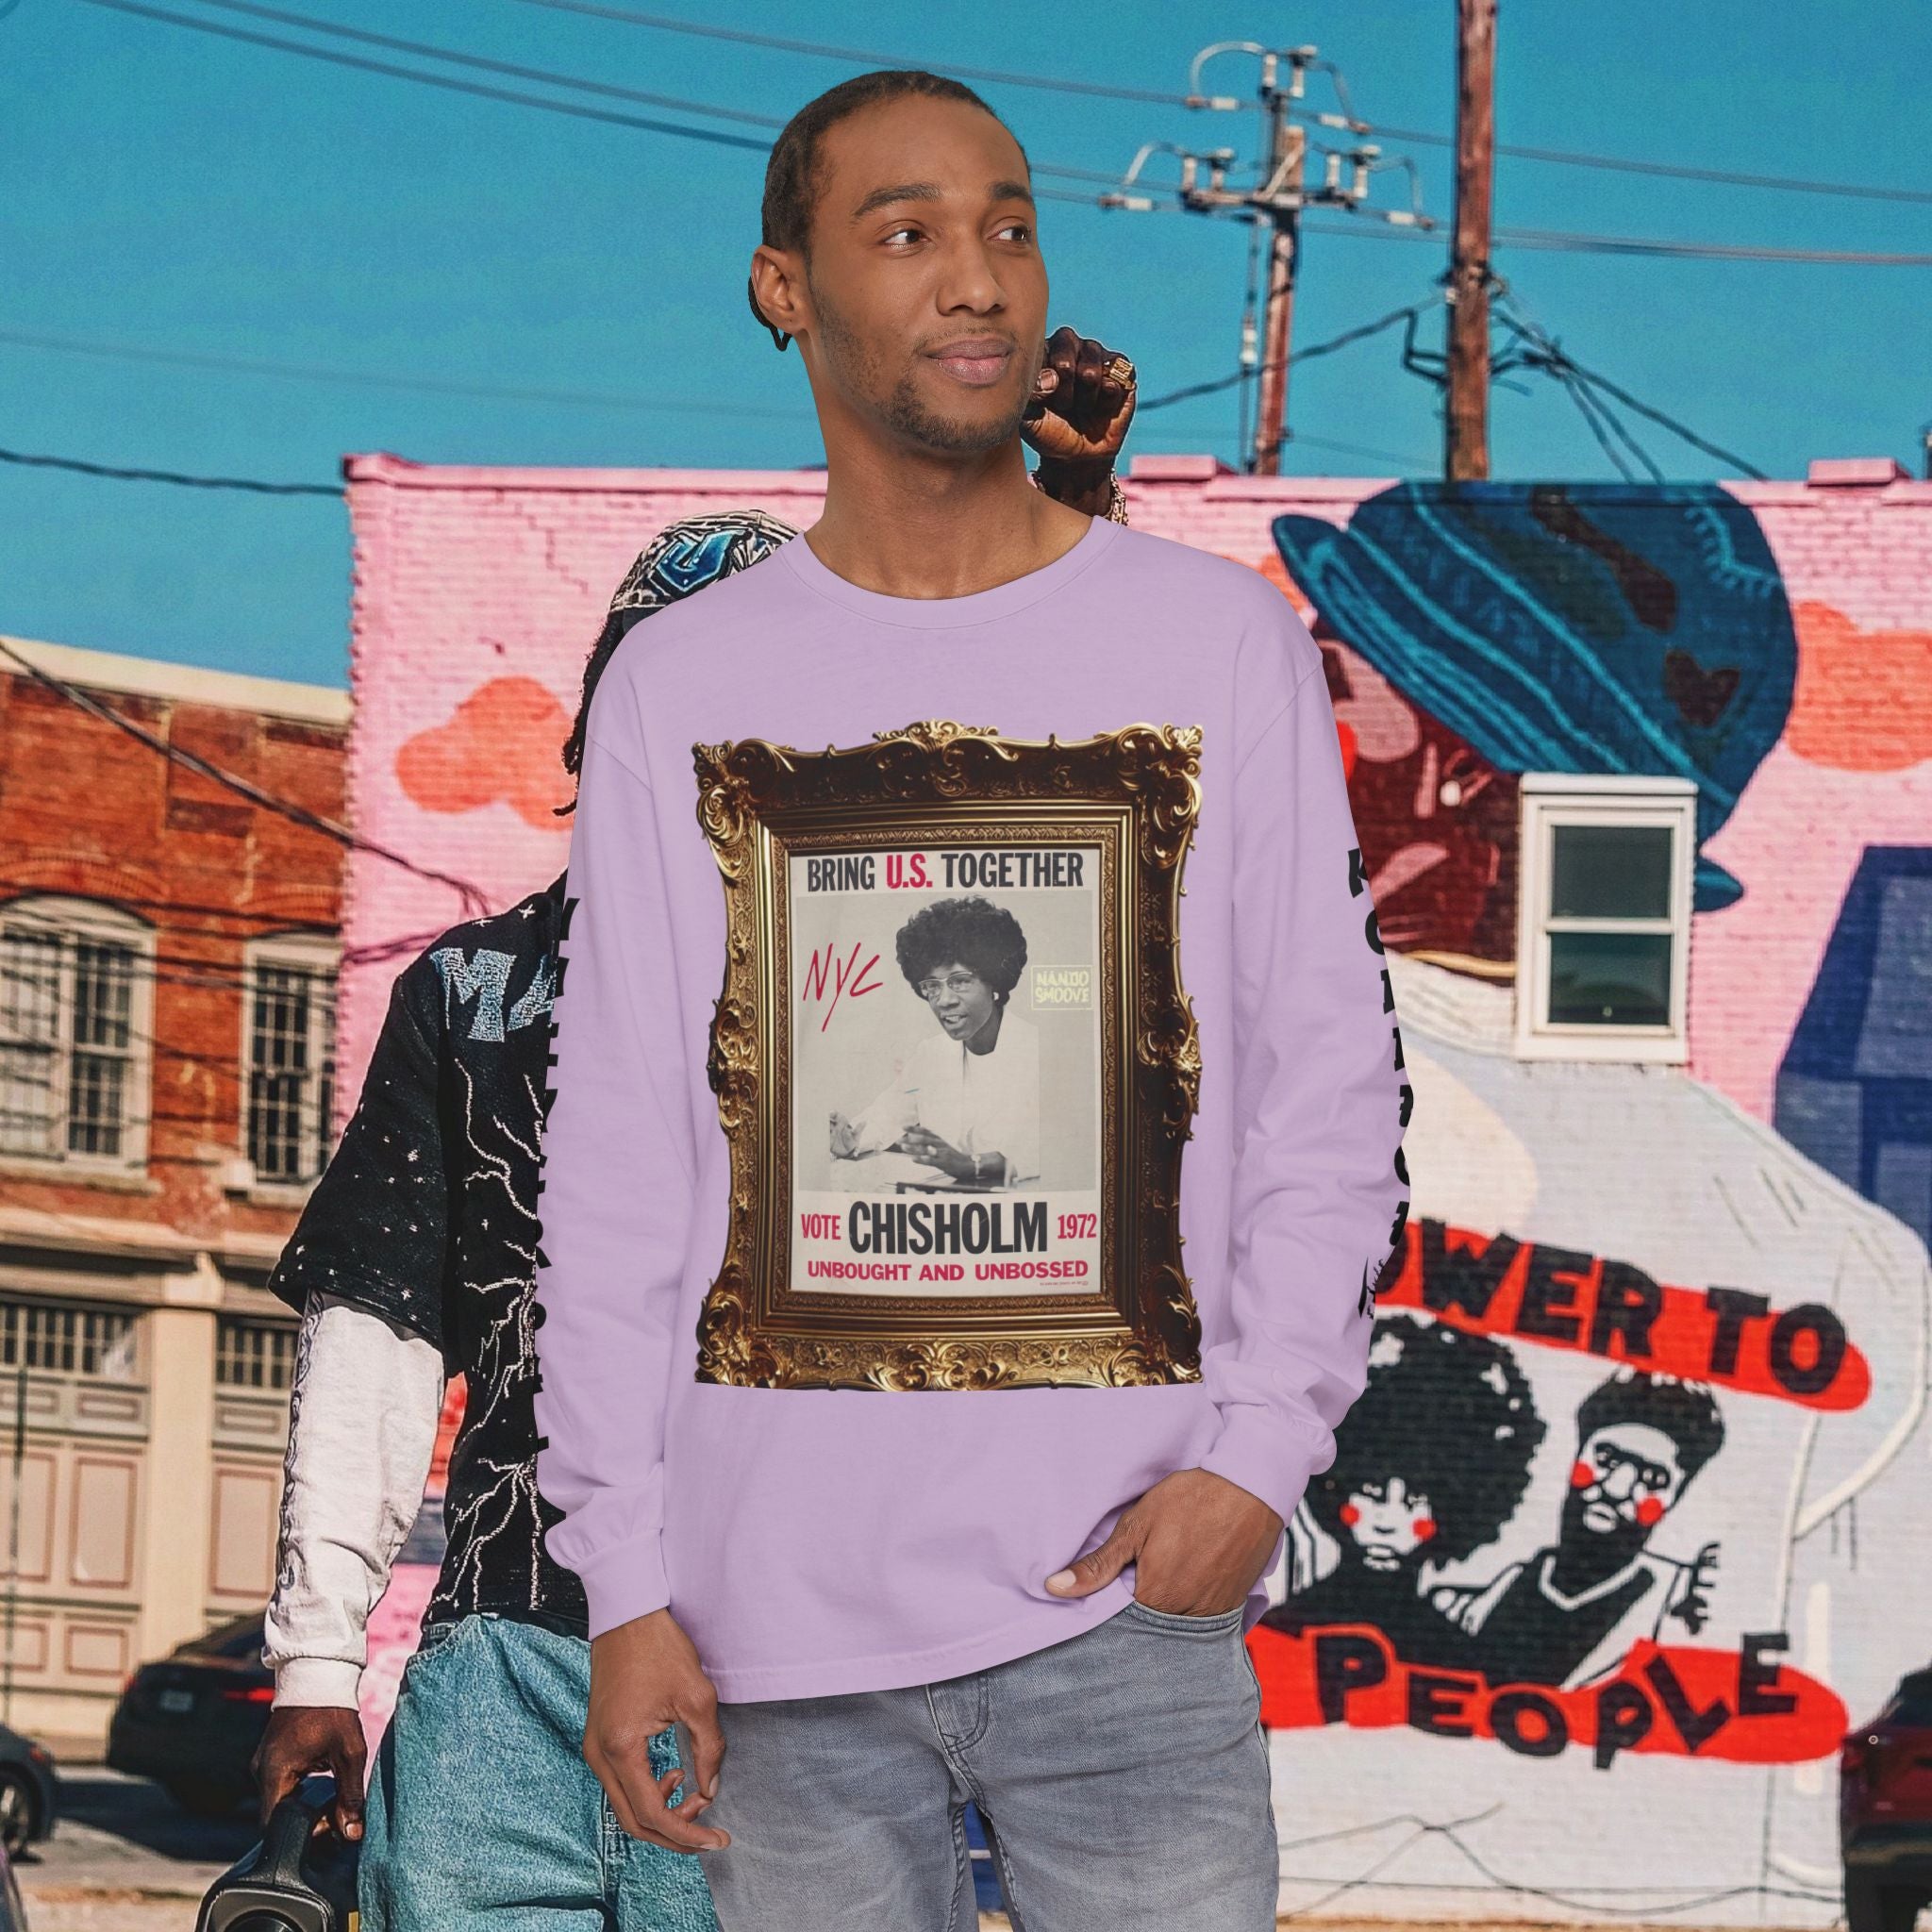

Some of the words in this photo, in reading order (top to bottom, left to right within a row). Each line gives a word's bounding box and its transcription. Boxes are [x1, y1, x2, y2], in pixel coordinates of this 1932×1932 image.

[807, 855, 875, 892] BRING
[886, 853, 933, 889] U.S.
[941, 852, 1084, 889] TOGETHER
[802, 942, 884, 1033] NYC
[1035, 987, 1090, 1004] SMOOVE
[801, 1213, 841, 1241] VOTE
[849, 1200, 1048, 1255] CHISHOLM
[1057, 1213, 1097, 1240] 1972
[808, 1260, 911, 1282] UNBOUGHT
[918, 1264, 965, 1281] AND
[974, 1259, 1089, 1281] UNBOSSED
[1707, 1286, 1848, 1395] TO
[1316, 1632, 1797, 1771] PEOPLE
